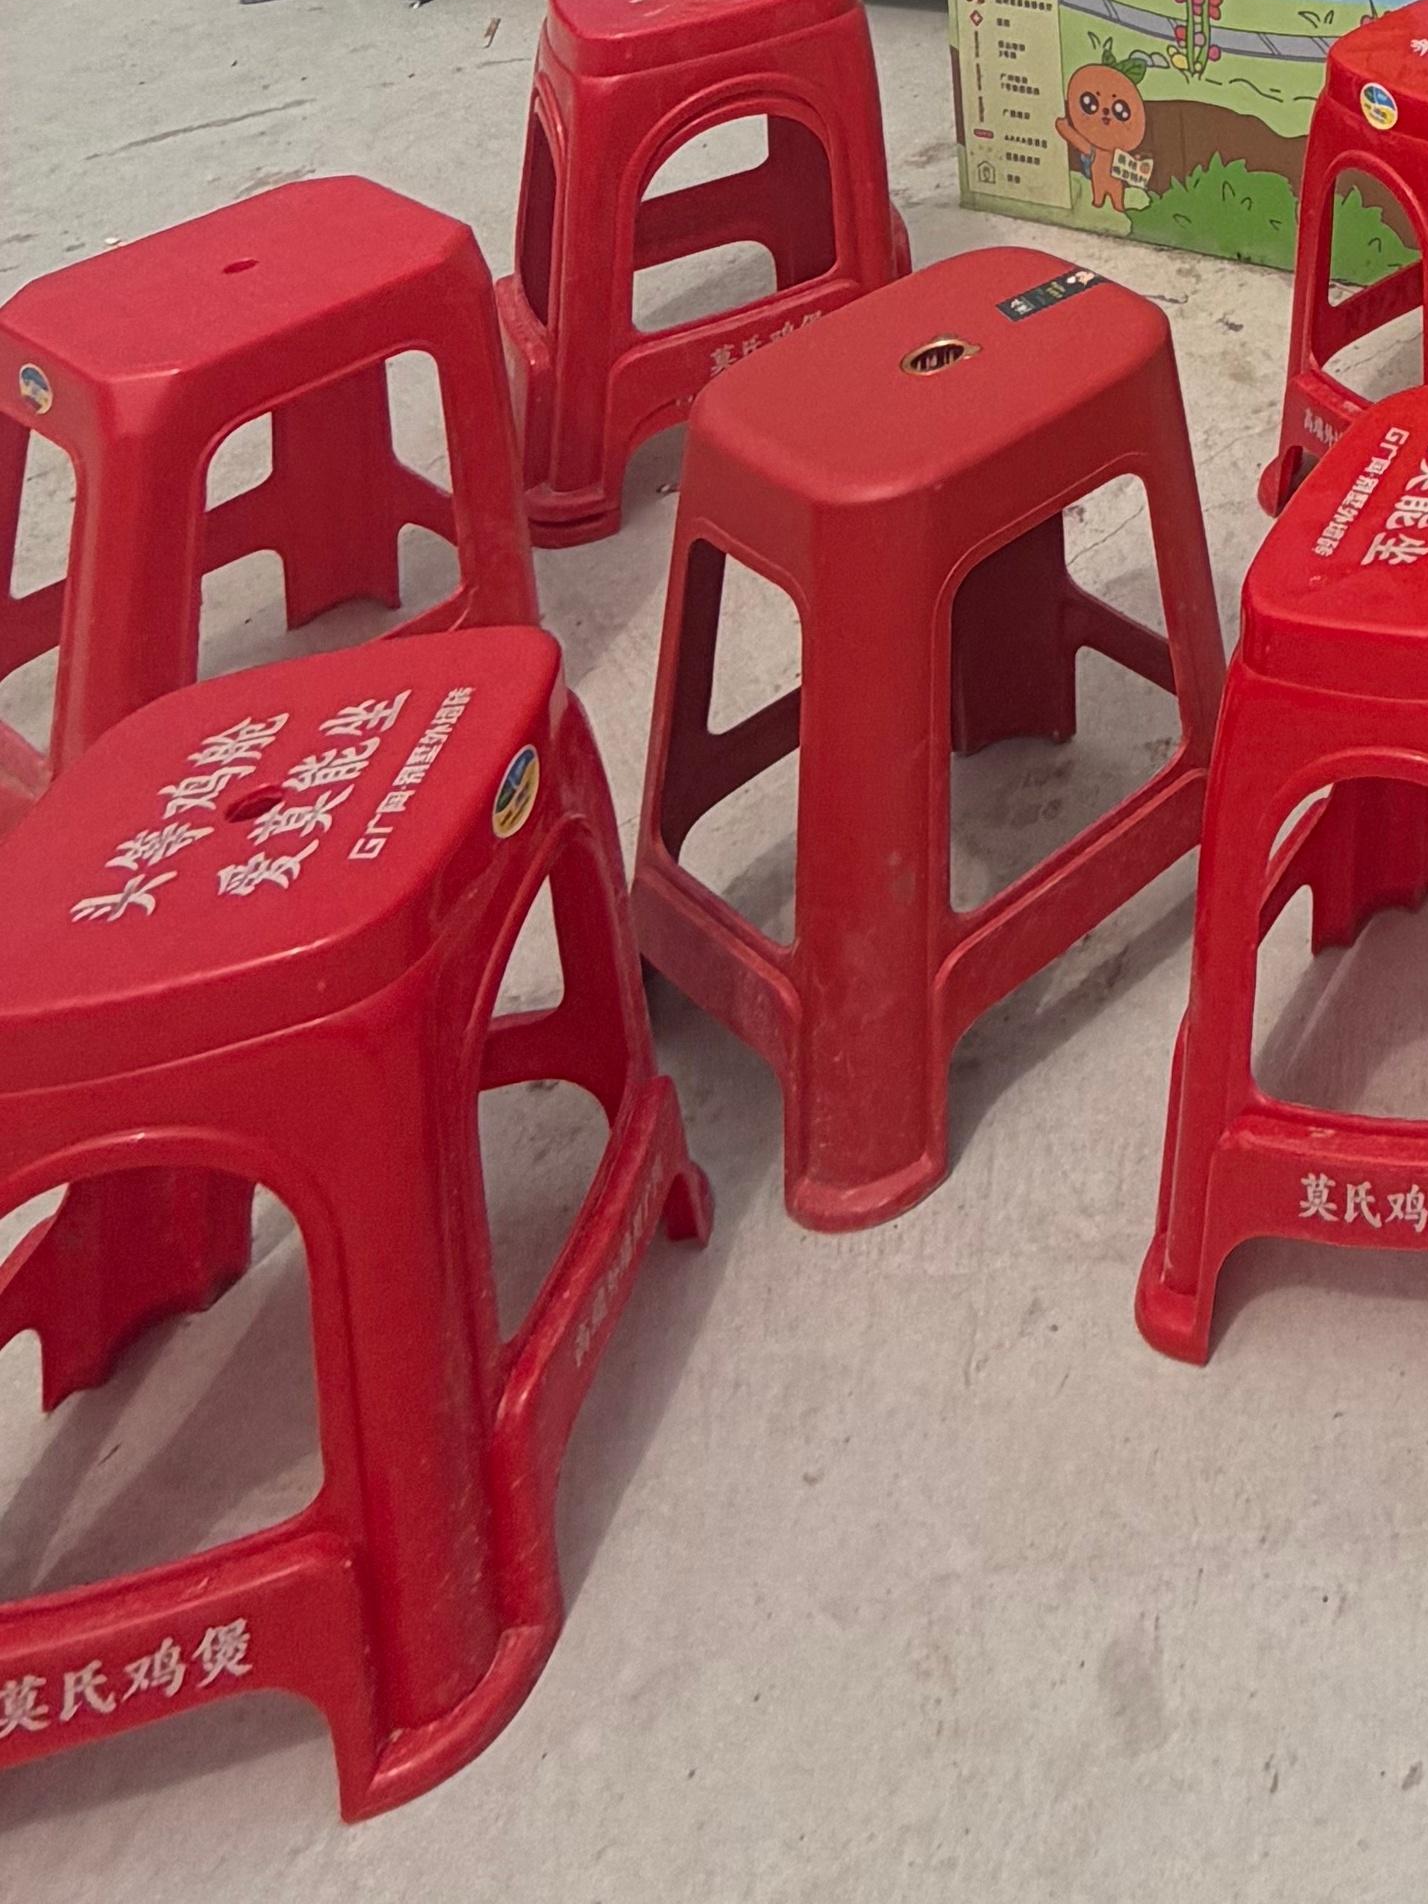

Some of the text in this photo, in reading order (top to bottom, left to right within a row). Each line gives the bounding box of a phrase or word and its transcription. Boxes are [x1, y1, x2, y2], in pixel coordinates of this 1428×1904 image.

[70, 710, 291, 928] 头等鸡舱
[0, 1615, 255, 1740] 莫氏鸡煲
